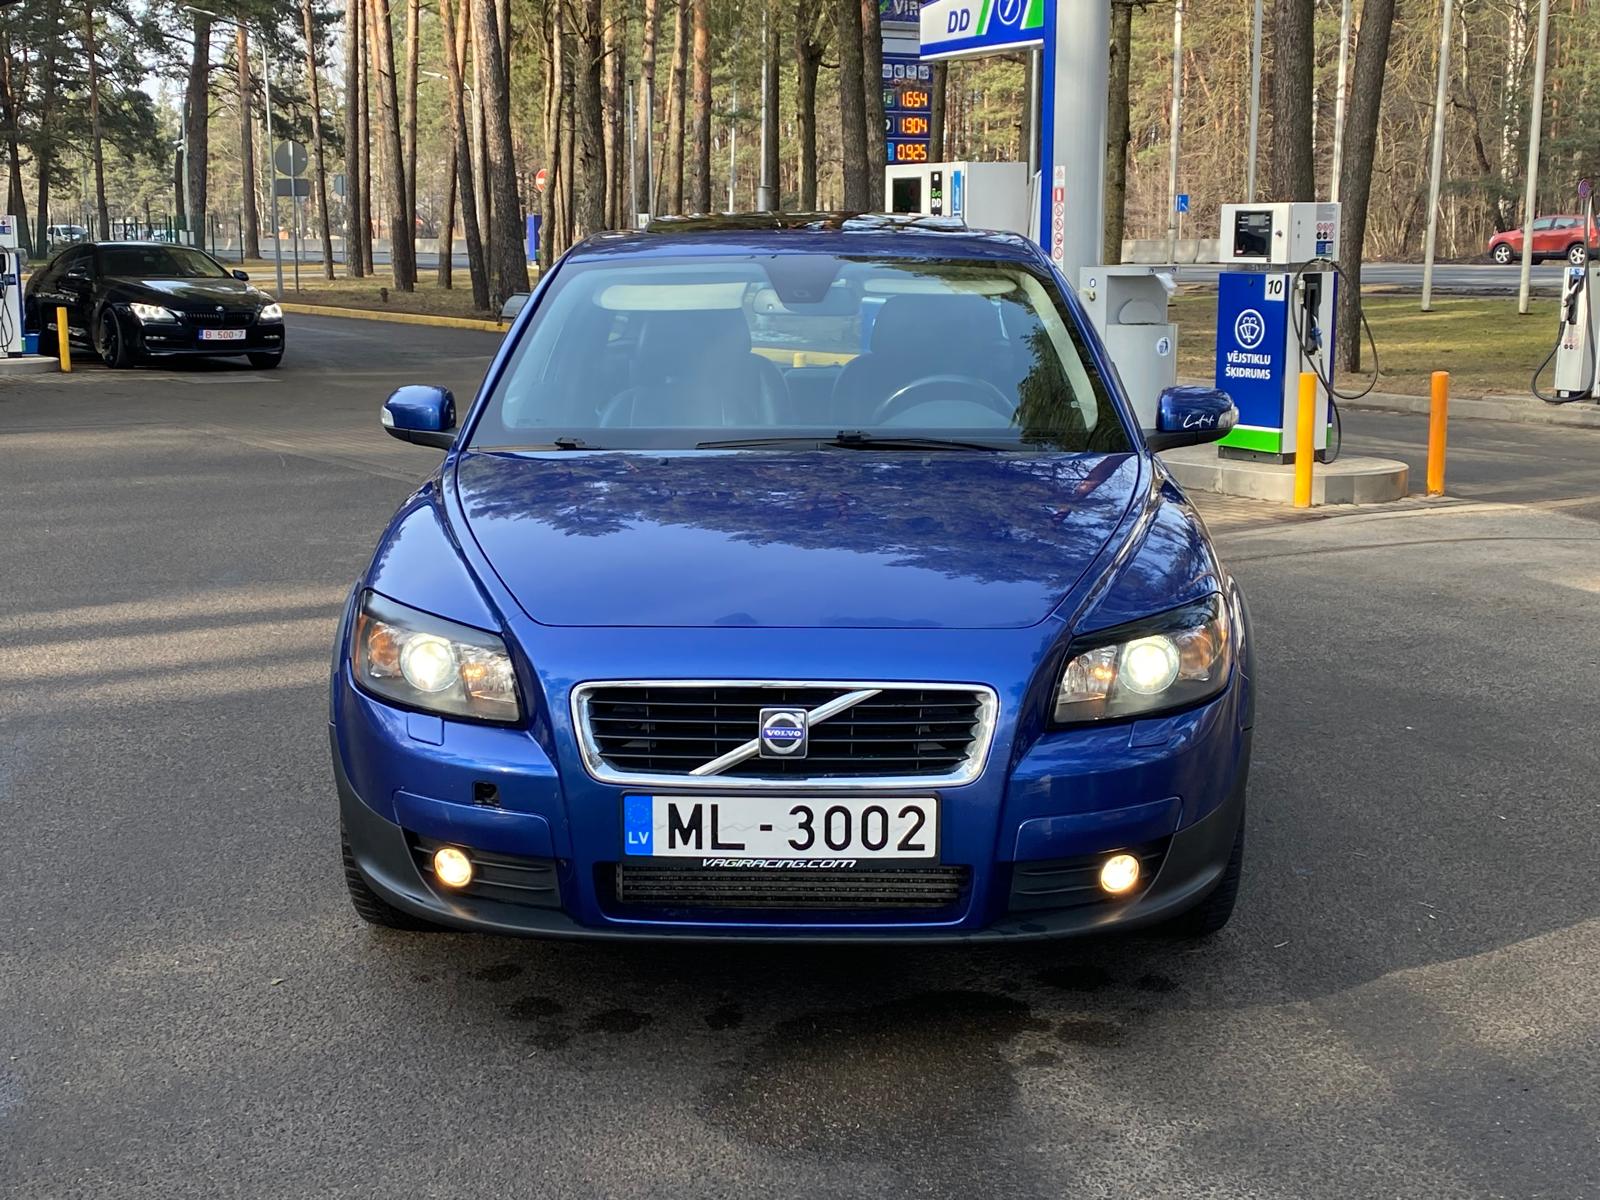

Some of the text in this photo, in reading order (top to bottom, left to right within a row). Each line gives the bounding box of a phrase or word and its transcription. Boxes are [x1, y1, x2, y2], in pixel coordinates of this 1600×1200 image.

[947, 8, 970, 33] DD
[897, 144, 927, 160] 0.925
[1268, 280, 1283, 294] 10
[1226, 350, 1271, 365] VĒJSTIKLU
[1225, 364, 1271, 380] ŠĶIDRUMS
[766, 729, 802, 737] VOLVO
[628, 831, 650, 845] LV
